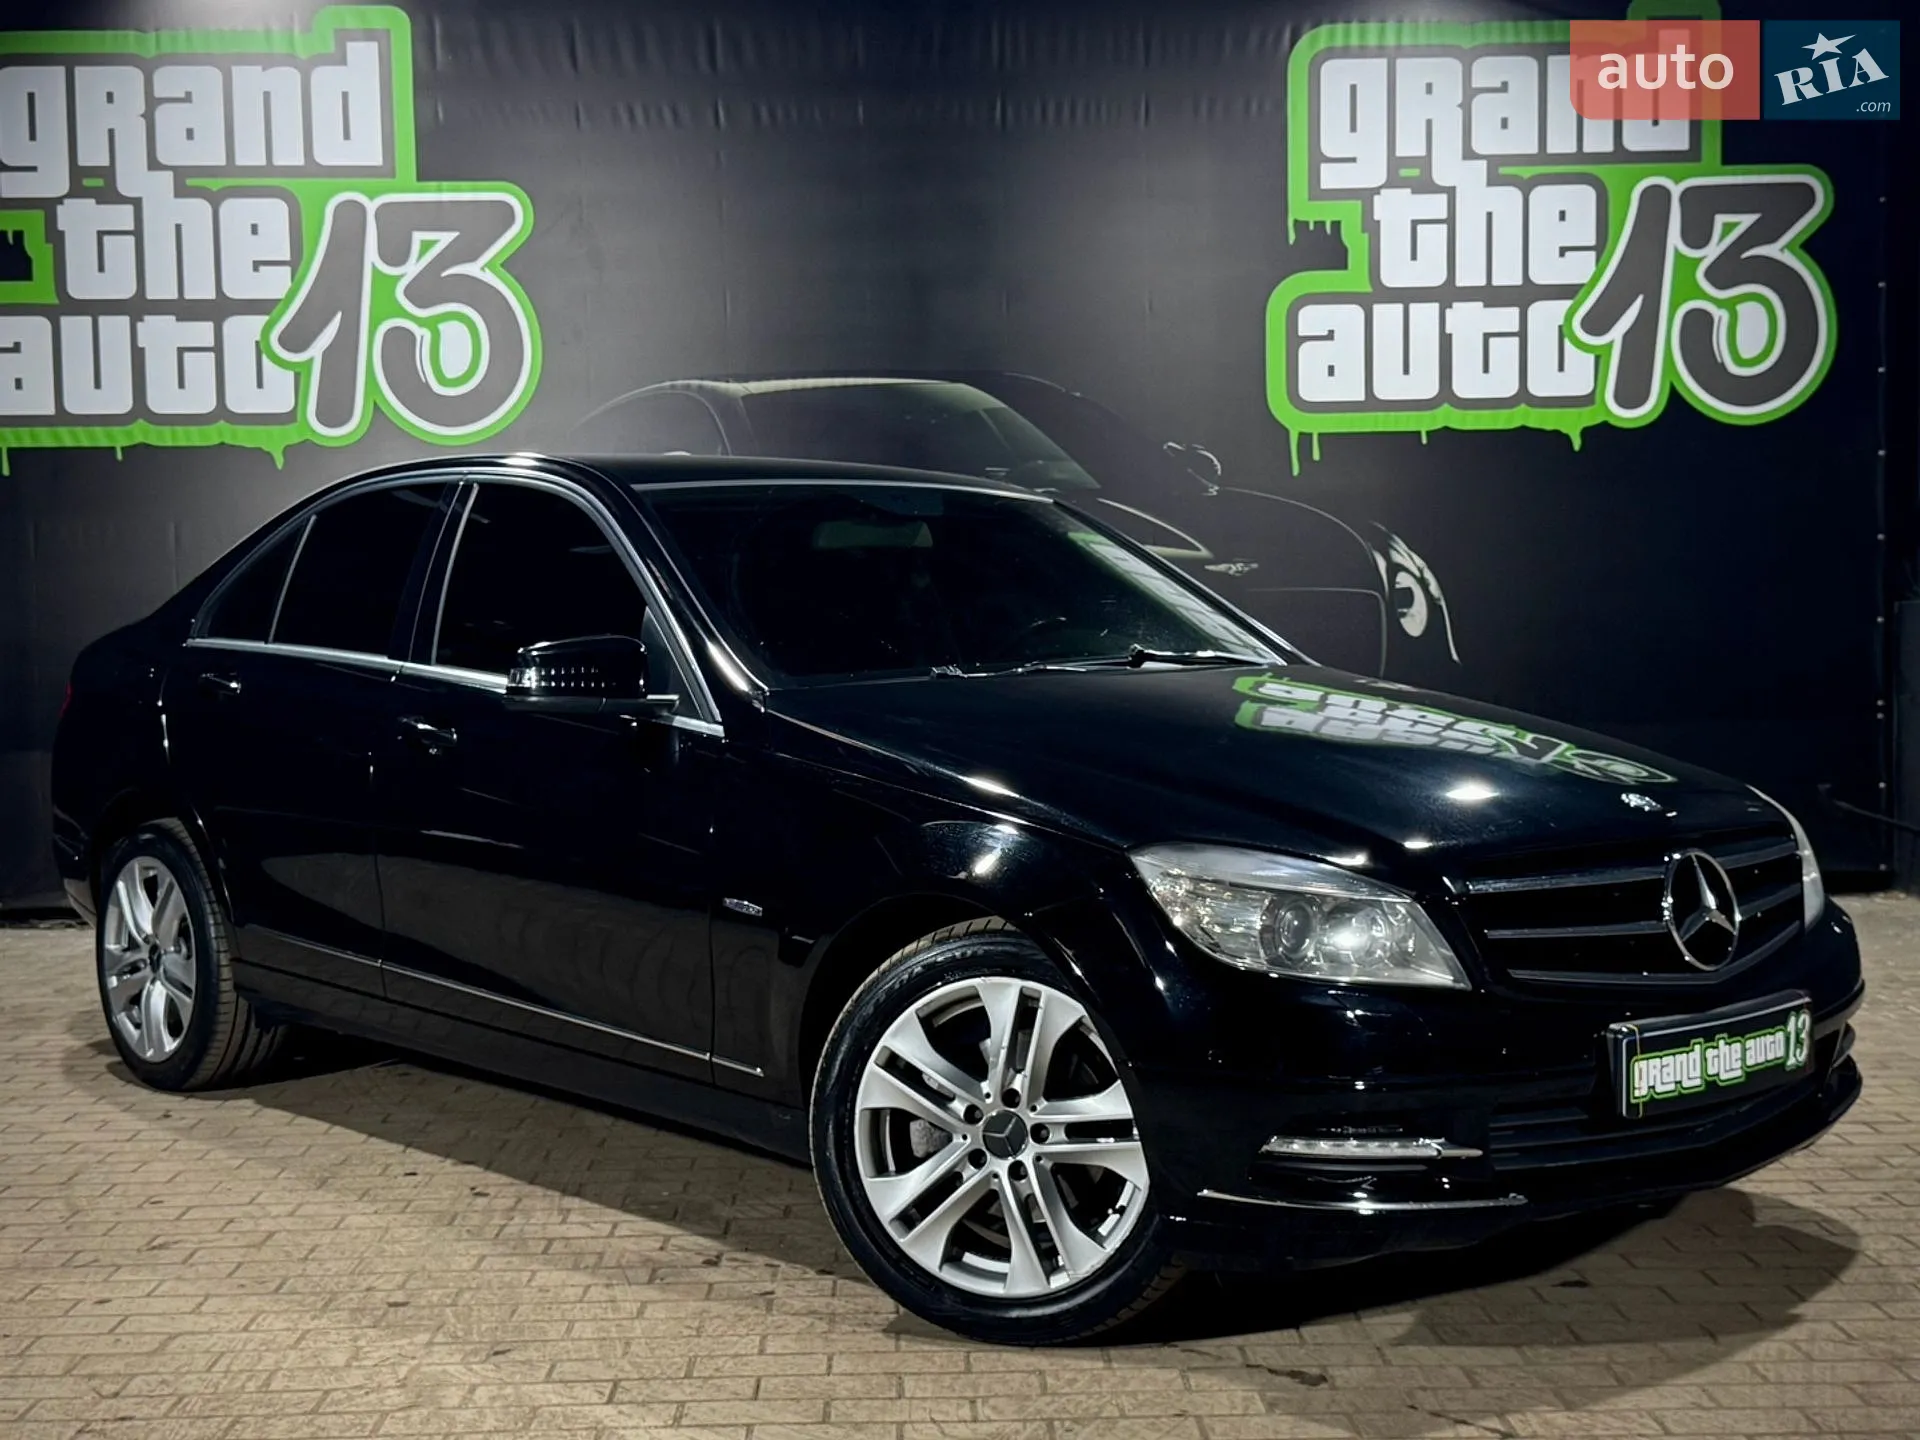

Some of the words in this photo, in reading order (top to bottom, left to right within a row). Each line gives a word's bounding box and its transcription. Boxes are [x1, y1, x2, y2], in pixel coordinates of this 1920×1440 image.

[57, 171, 292, 299] the
[1373, 159, 1597, 288] the
[271, 192, 530, 436] 13
[1298, 300, 1596, 402] auto
[1571, 174, 1828, 418] 13
[1705, 1038, 1743, 1081] the
[1745, 1029, 1785, 1067] auto
[1786, 1010, 1812, 1066] 13
